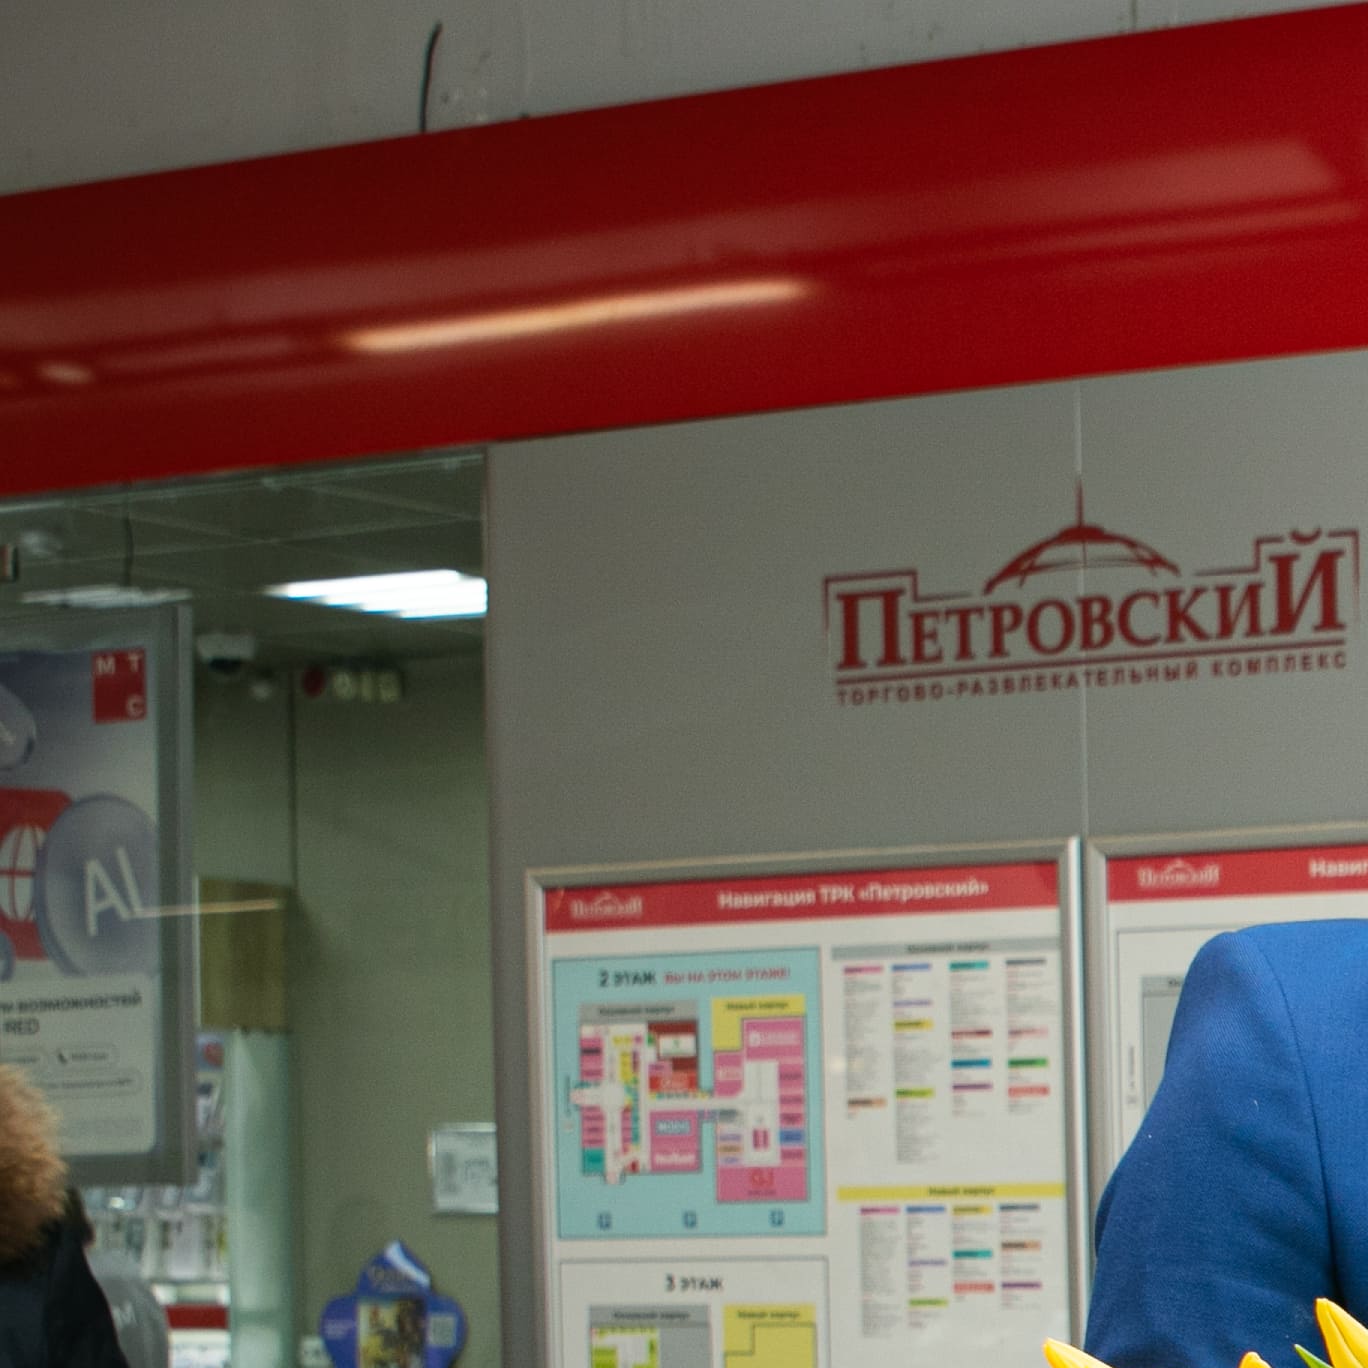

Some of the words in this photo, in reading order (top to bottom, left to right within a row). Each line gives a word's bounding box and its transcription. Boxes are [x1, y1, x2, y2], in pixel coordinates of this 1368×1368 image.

[837, 661, 1199, 706] ТОРГОВО-РАЗВЛЕКАТЕЛЬНЫЙ
[1211, 651, 1346, 678] КОМПЛЕКС
[717, 888, 816, 910] Навигация
[819, 884, 855, 904] ТРК
[614, 969, 657, 987] ЭТАЖ
[680, 1276, 724, 1292] ЭТАЖ
